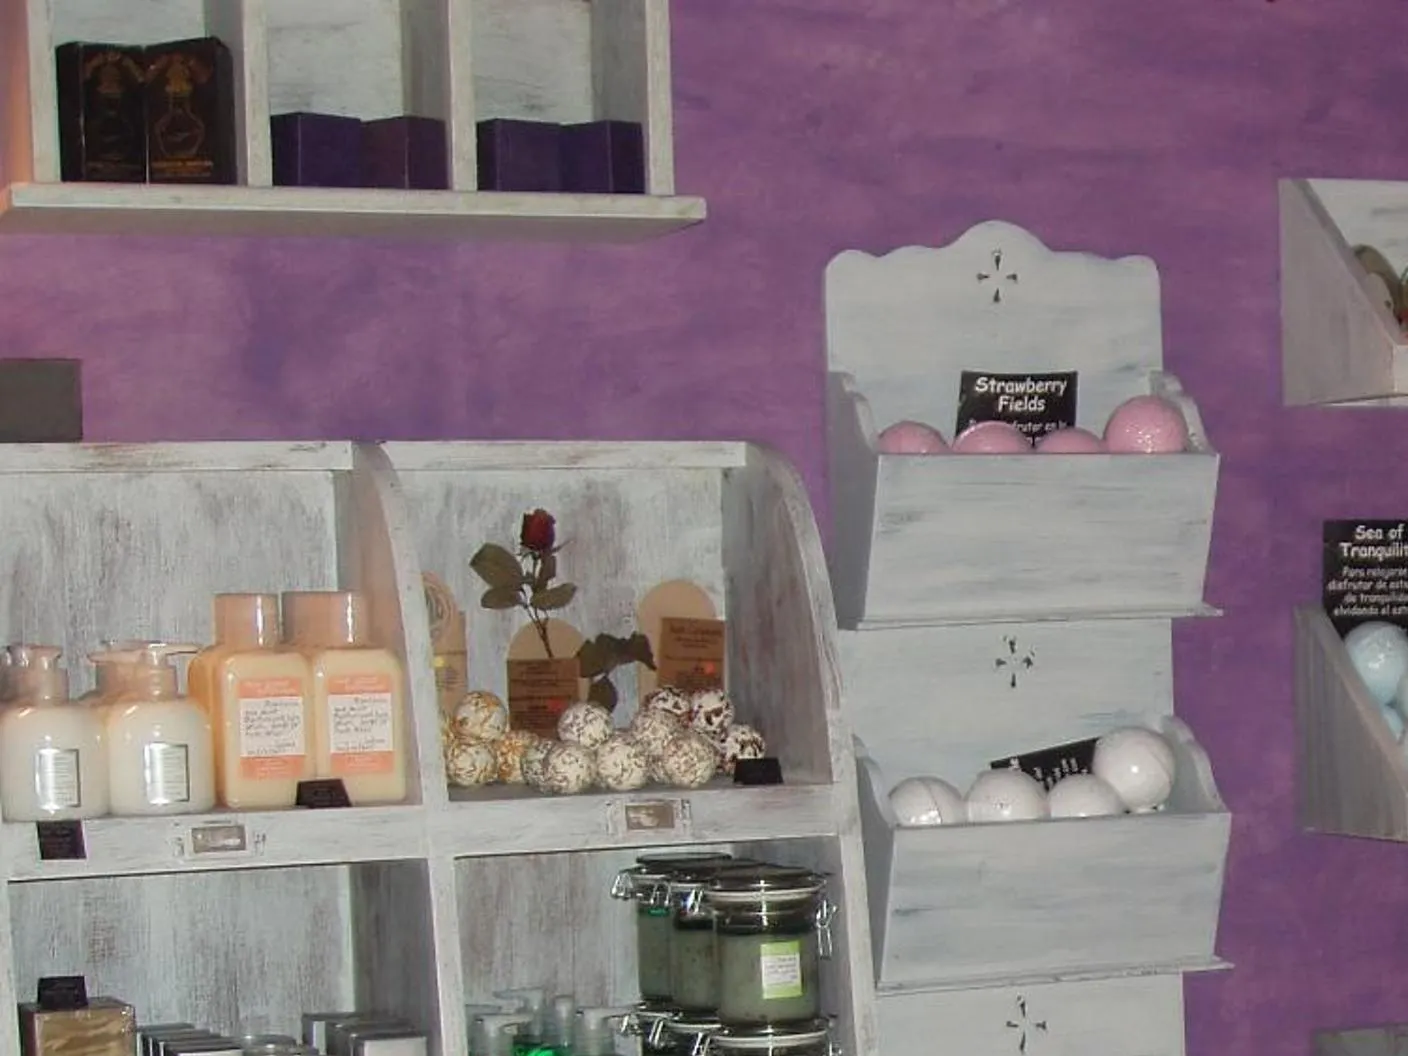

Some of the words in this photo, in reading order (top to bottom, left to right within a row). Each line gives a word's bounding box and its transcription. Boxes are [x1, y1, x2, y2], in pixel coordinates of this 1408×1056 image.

[975, 377, 1067, 396] Strawberry
[998, 395, 1045, 412] Fields
[1355, 525, 1383, 540] Sea
[1388, 523, 1405, 539] of
